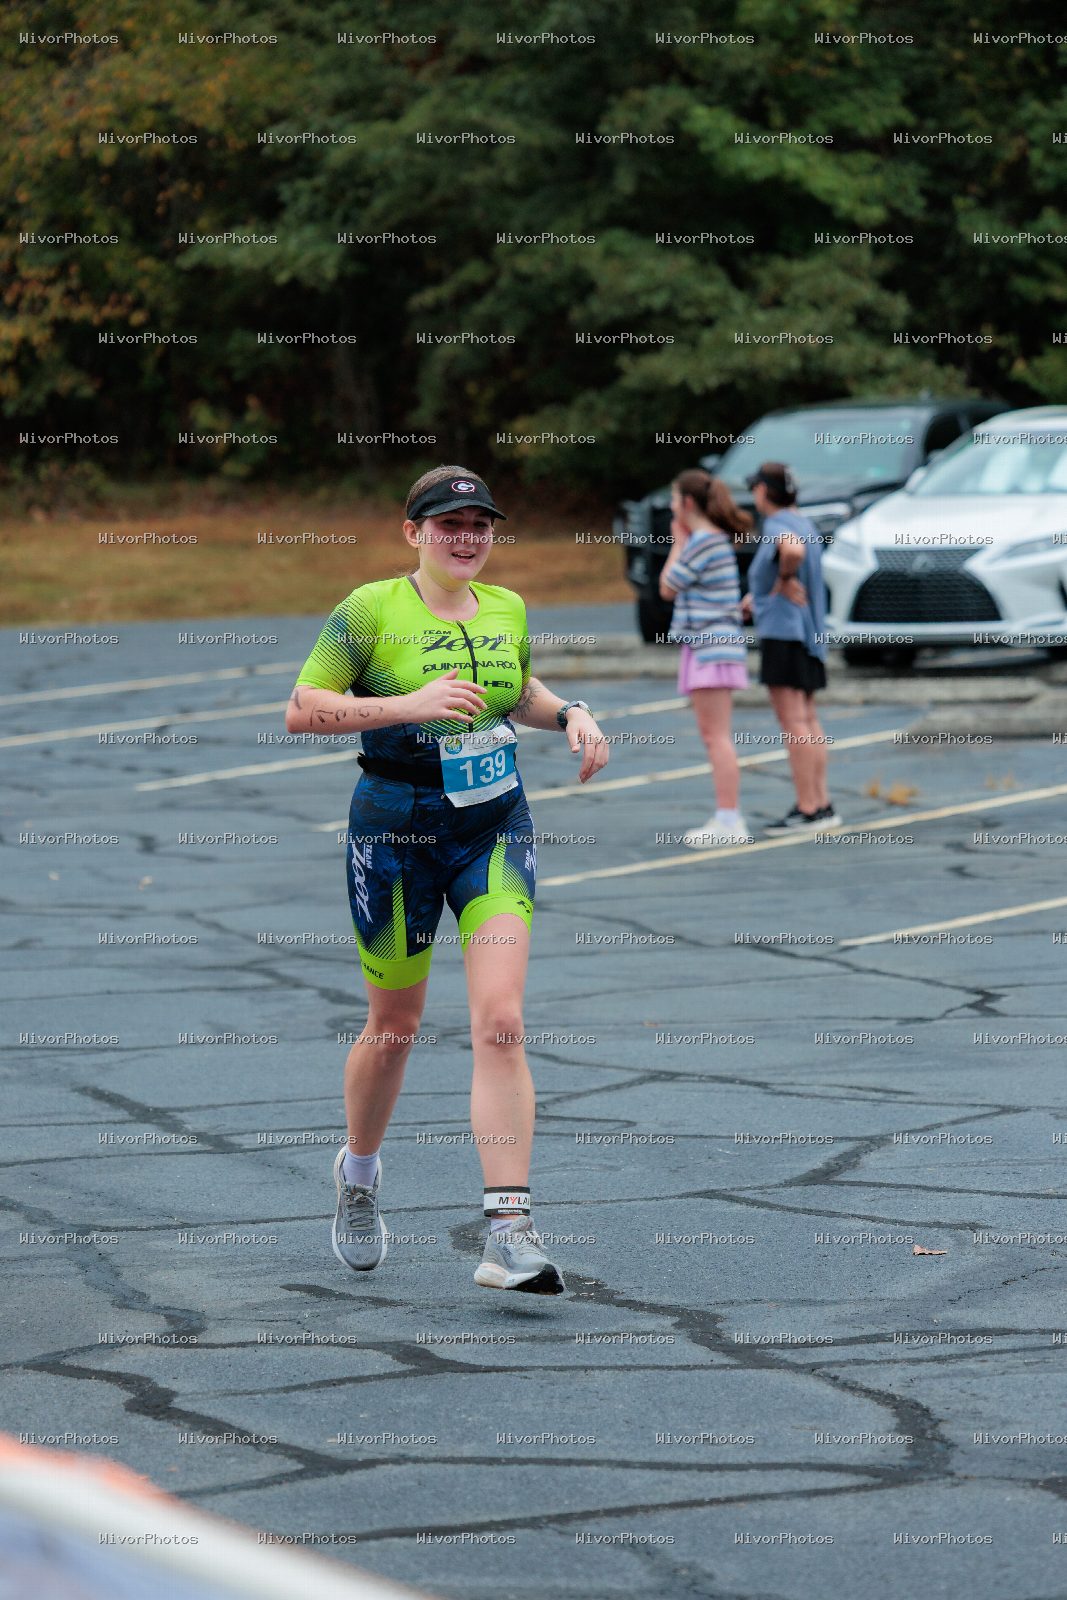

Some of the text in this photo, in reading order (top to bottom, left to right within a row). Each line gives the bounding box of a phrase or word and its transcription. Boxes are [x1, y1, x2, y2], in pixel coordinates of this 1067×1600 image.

[496, 660, 517, 670] ROO
[460, 749, 506, 787] 139
[365, 844, 373, 869] TEAM
[498, 1196, 530, 1205] MYLA
